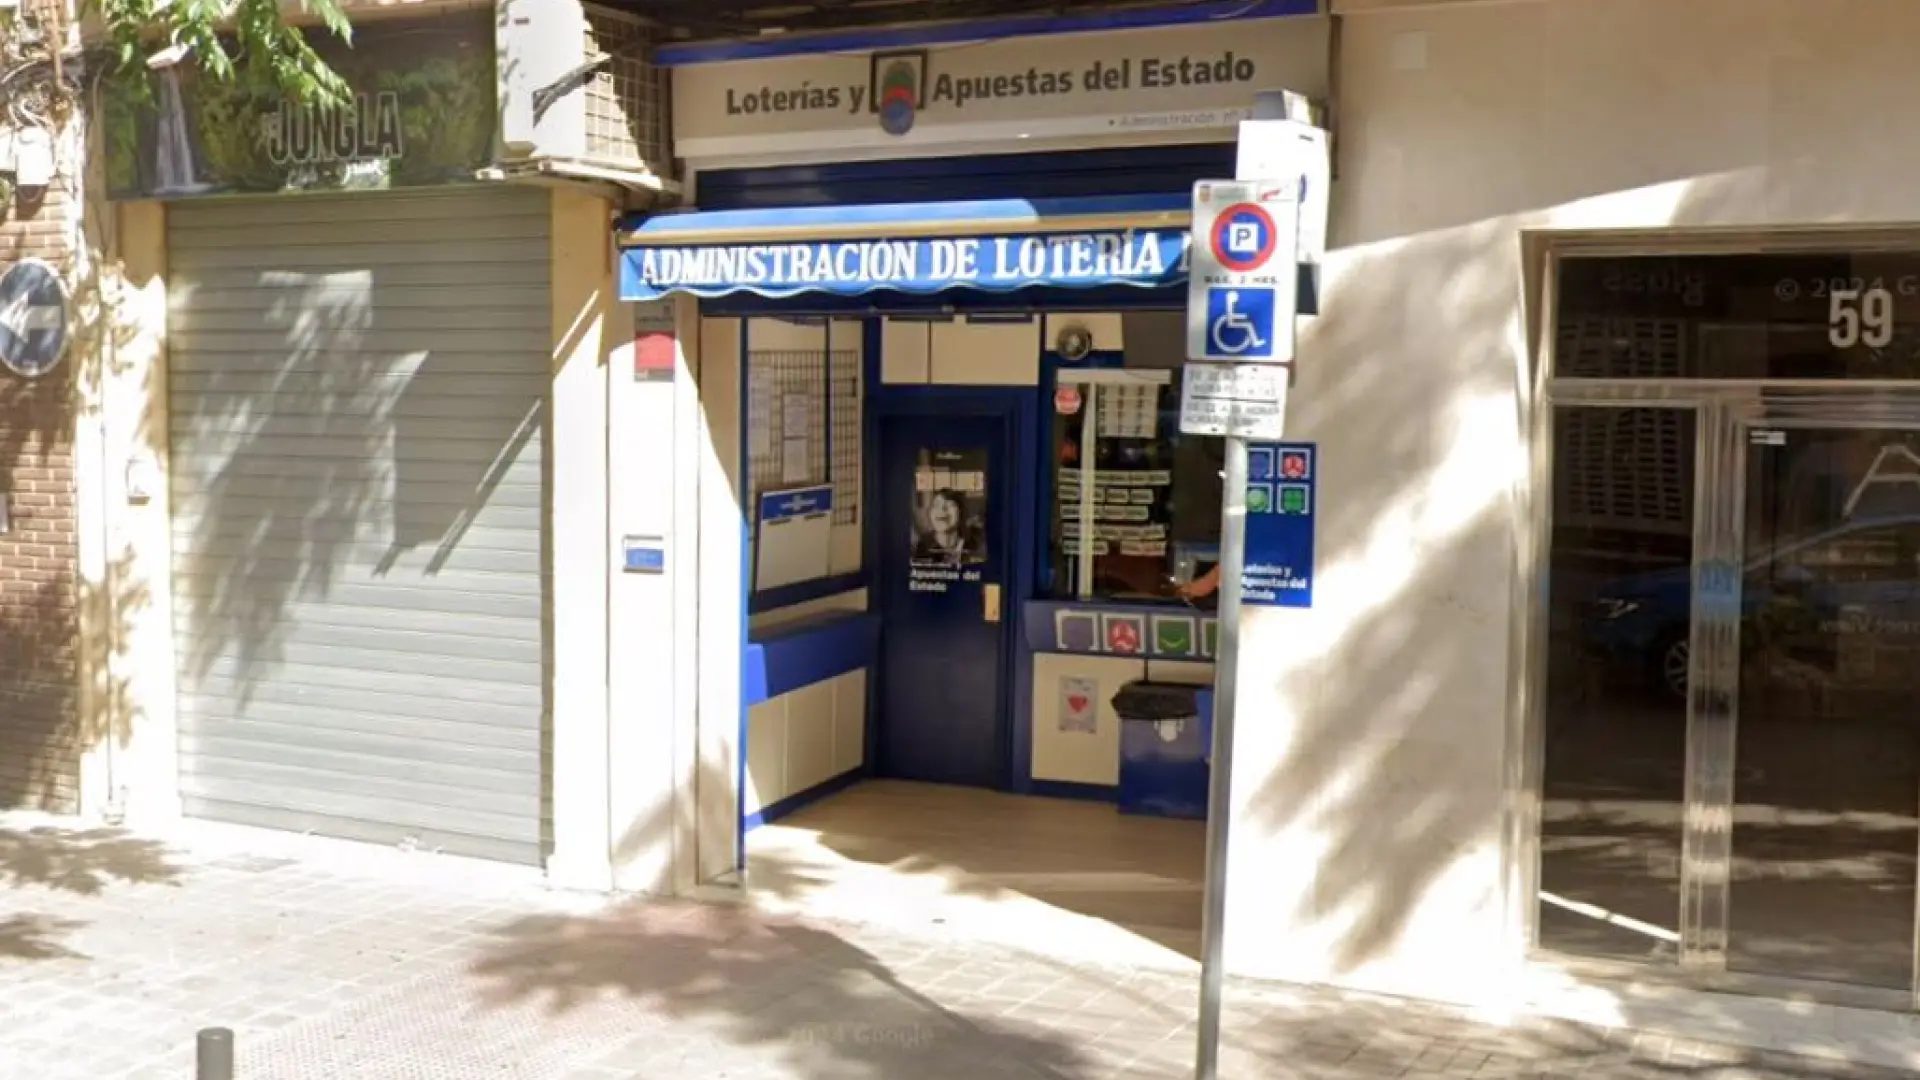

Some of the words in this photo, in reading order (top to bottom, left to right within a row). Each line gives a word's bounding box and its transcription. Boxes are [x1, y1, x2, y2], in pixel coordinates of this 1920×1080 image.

[726, 81, 841, 115] Loterías
[848, 84, 866, 114] y
[933, 68, 1073, 107] Apuestas
[1083, 59, 1131, 92] del
[1140, 51, 1256, 87] Estado
[268, 91, 403, 165] JUNGLA
[640, 239, 918, 286] ADMINISTRACIÓN
[928, 239, 980, 281] DE
[993, 229, 1166, 280] LOTERÍA
[1235, 227, 1252, 247] P
[1828, 288, 1893, 348] 59
